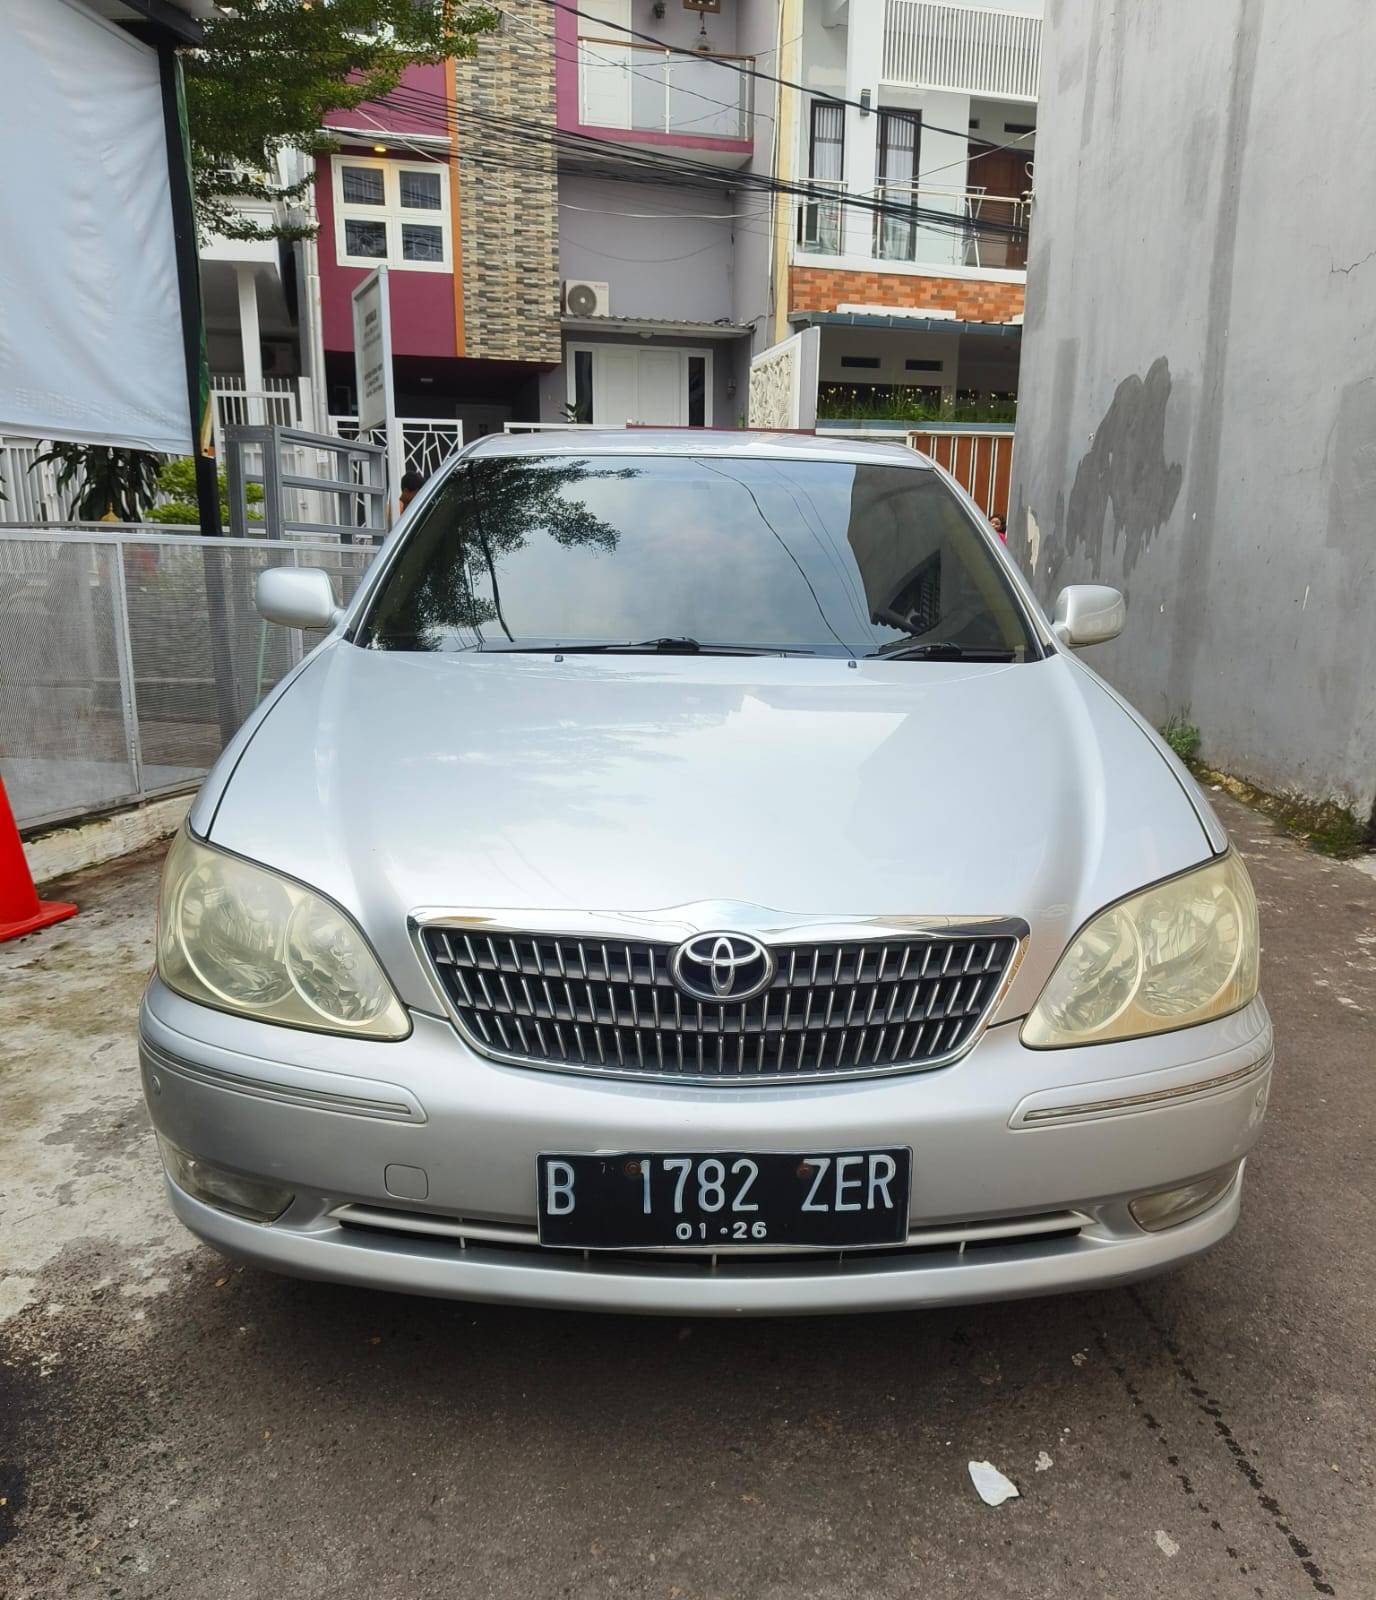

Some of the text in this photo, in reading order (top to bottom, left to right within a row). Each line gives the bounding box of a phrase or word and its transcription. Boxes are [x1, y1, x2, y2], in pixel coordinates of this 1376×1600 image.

[546, 1154, 897, 1215] B 1782 ZER
